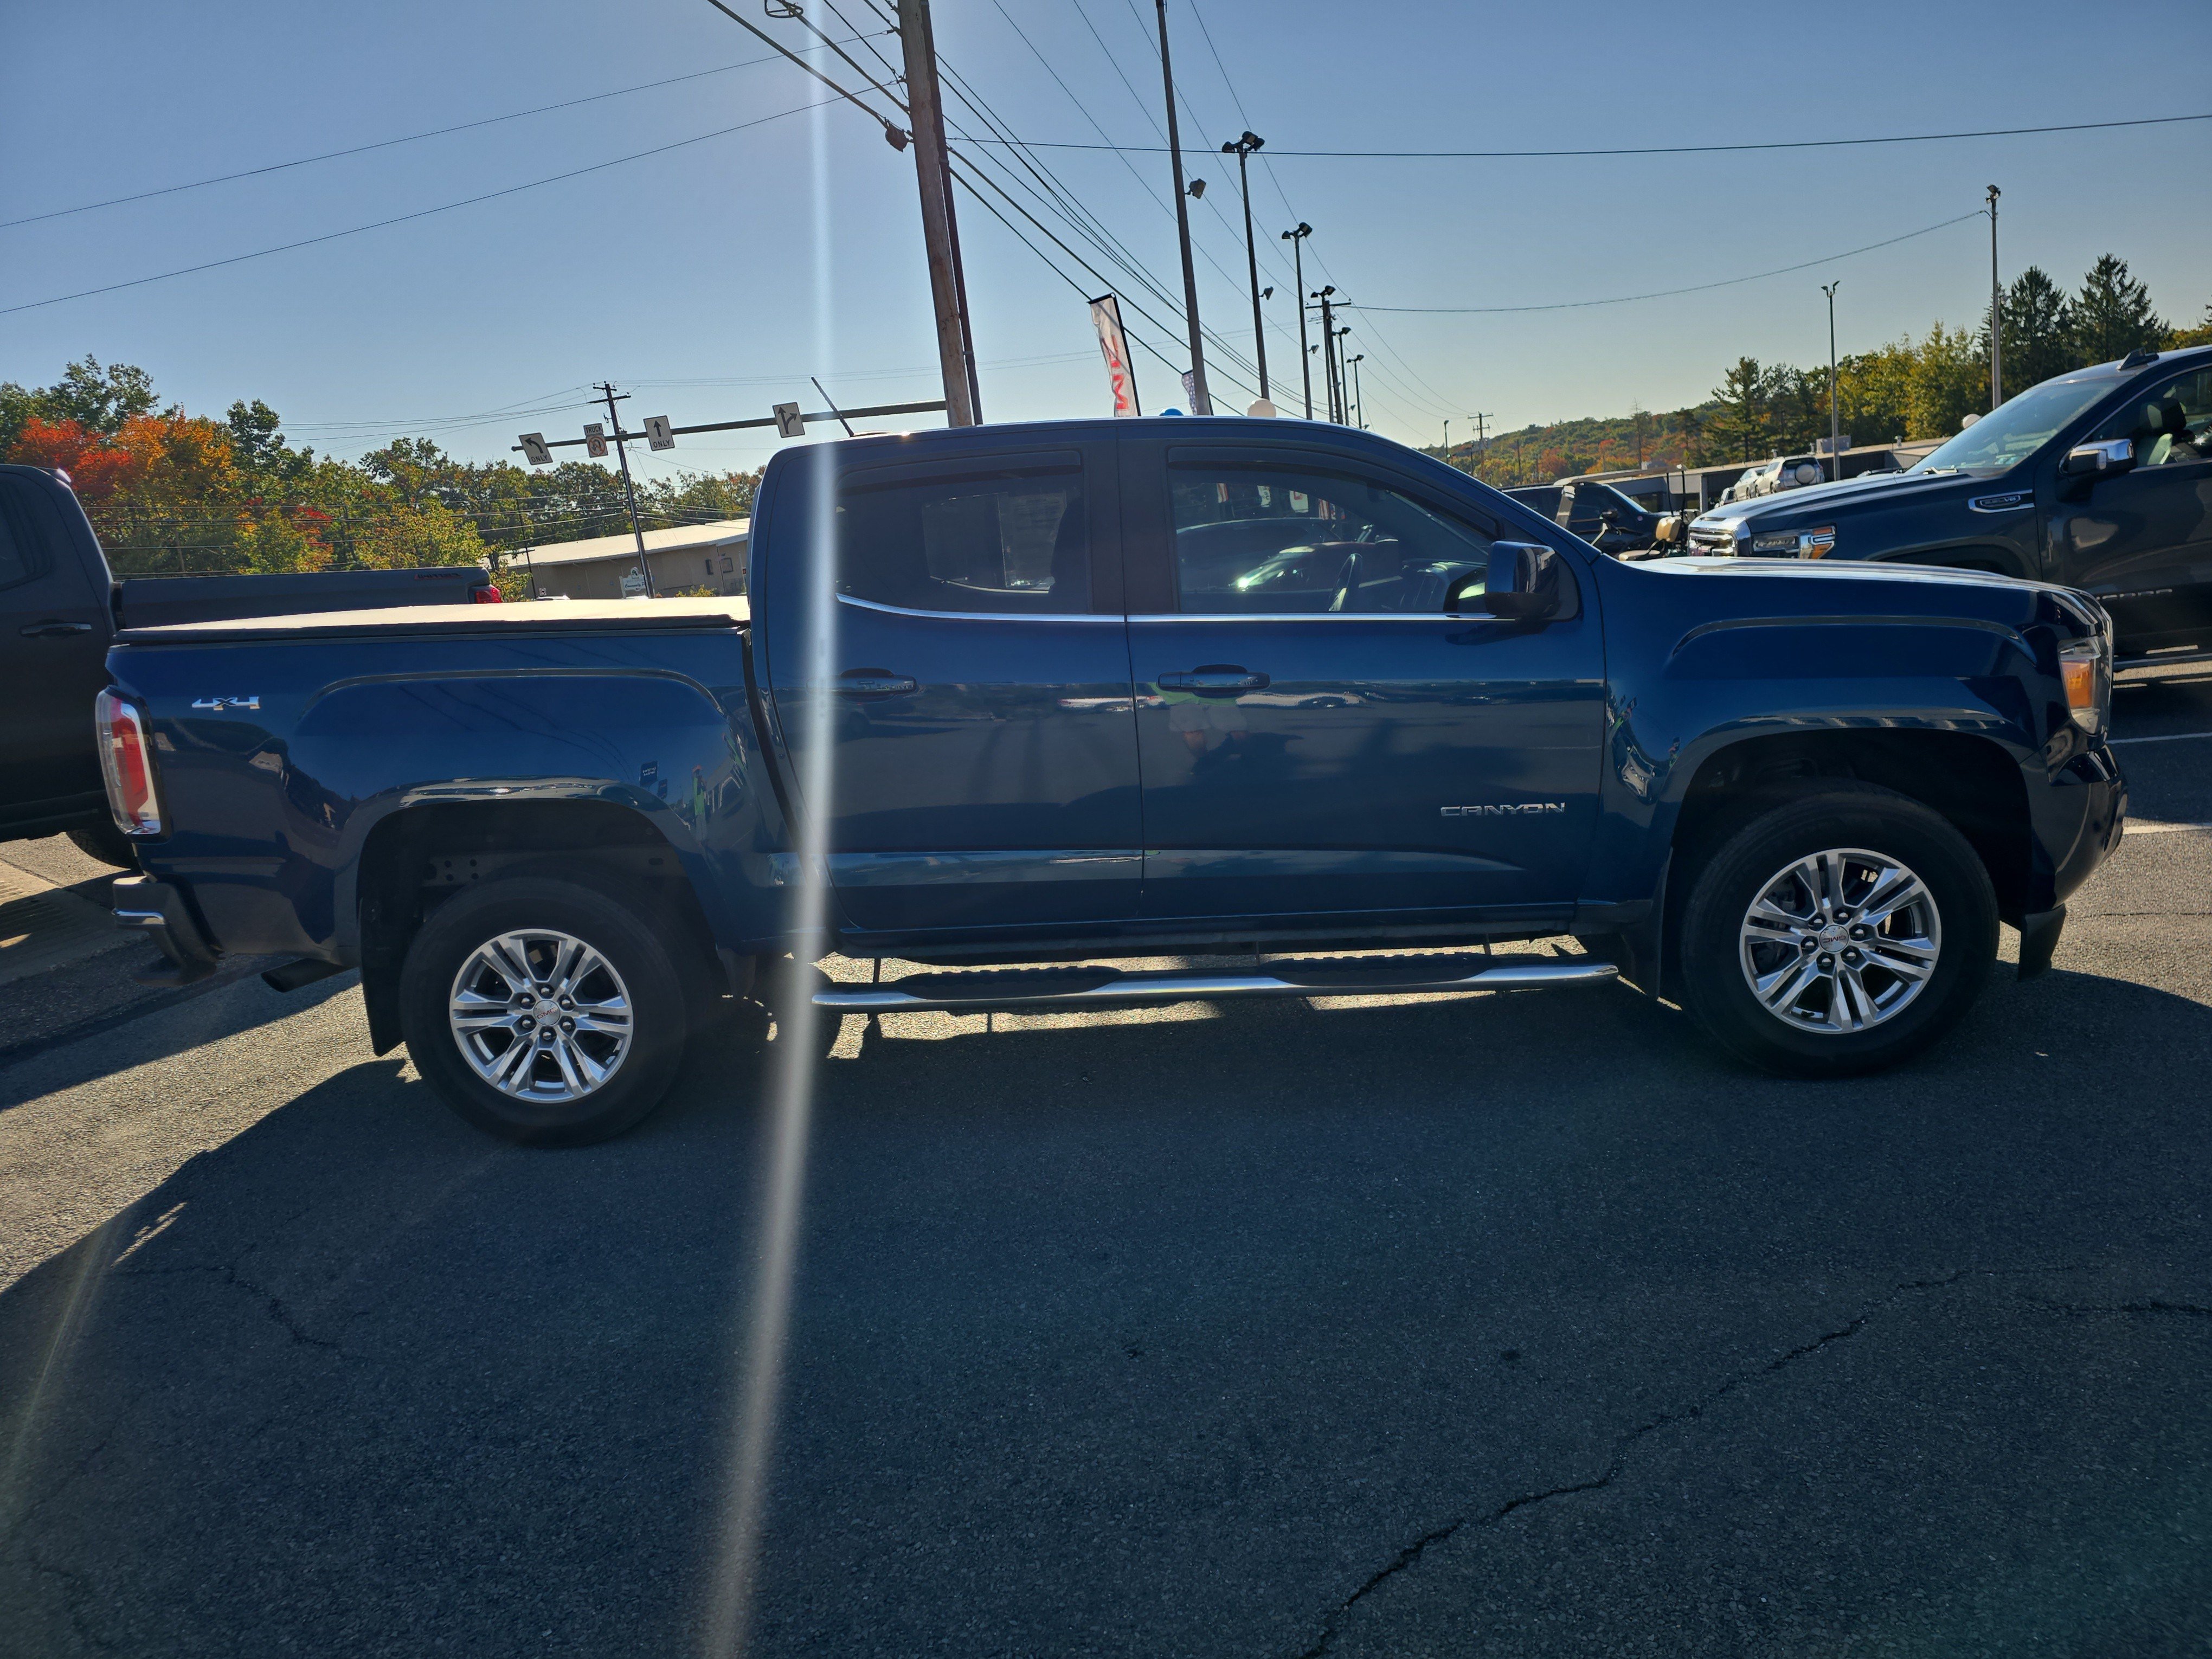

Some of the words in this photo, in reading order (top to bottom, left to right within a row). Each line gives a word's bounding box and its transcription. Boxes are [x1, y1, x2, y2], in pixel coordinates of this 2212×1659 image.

[586, 425, 602, 433] TRUCK
[653, 440, 670, 448] ONLY
[1440, 802, 1565, 817] CANYON
[1822, 935, 1846, 943] GMC
[536, 1007, 558, 1019] GMC
